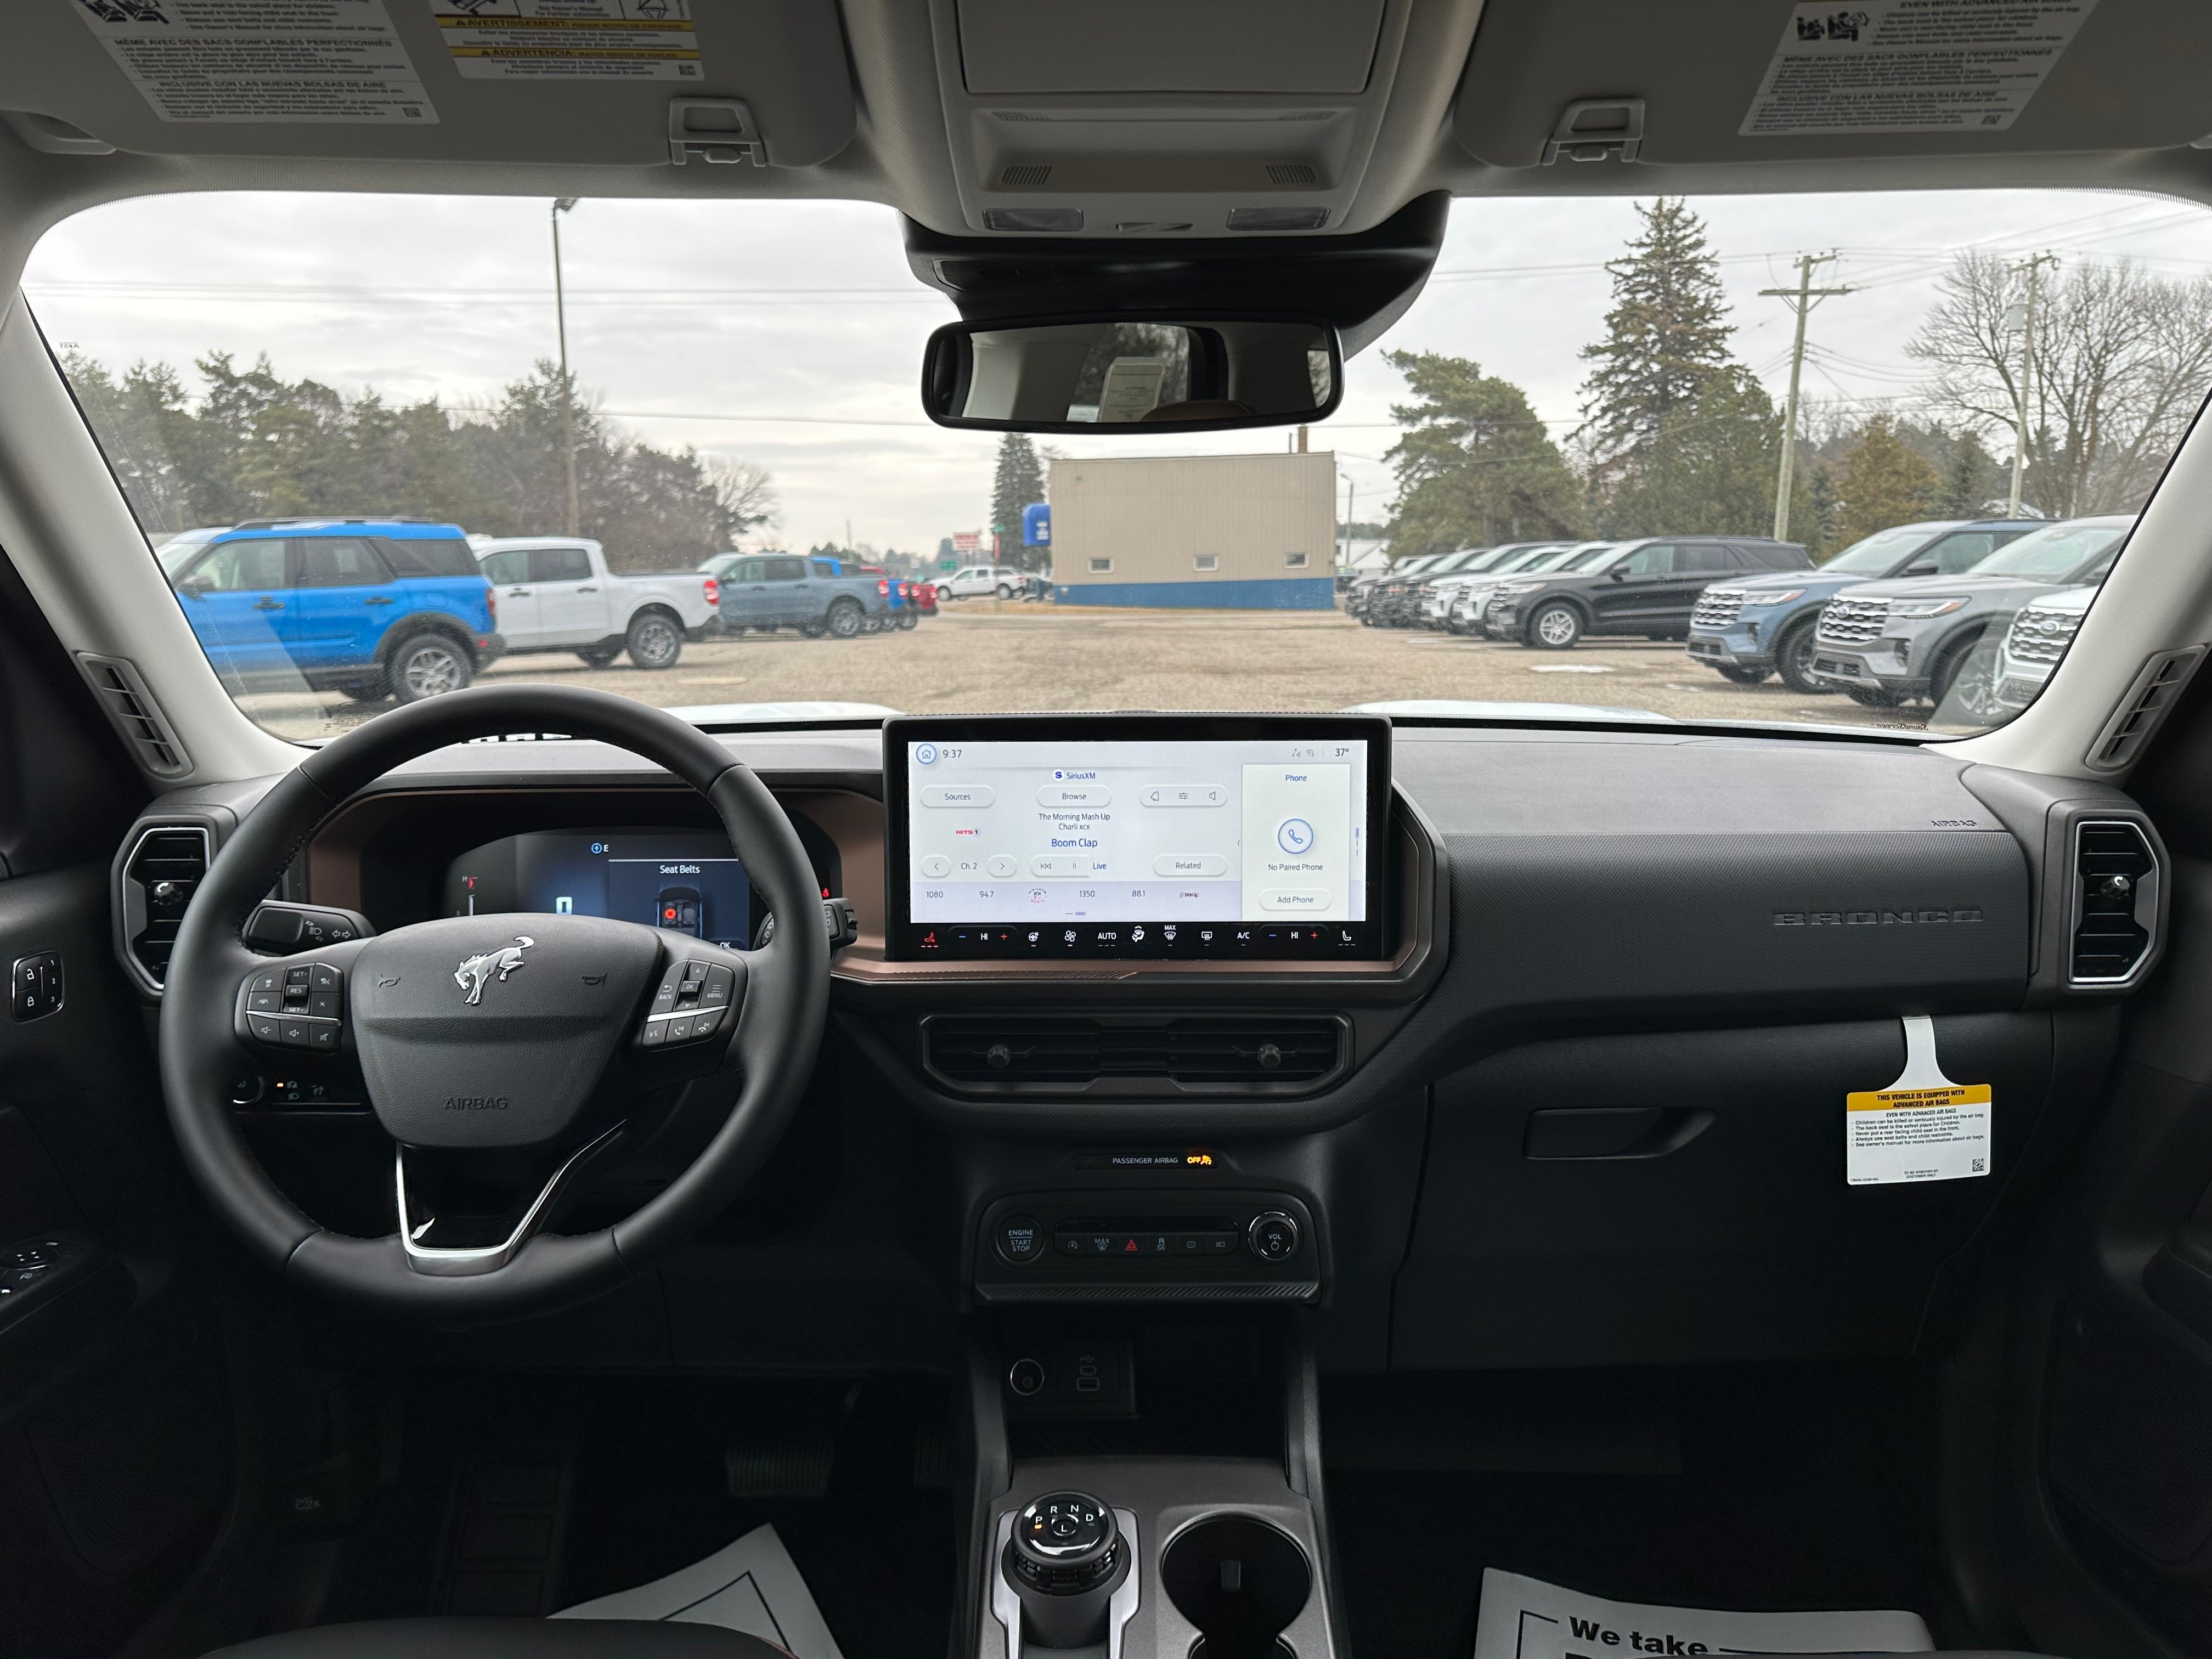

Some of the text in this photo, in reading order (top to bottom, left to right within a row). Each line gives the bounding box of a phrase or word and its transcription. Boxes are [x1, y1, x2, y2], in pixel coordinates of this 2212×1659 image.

[943, 749, 962, 758] 9:37
[1335, 748, 1349, 757] 37°
[1101, 814, 1110, 822] Up
[1052, 838, 1097, 849] Boom Clap
[659, 865, 700, 874] Seat Belts
[1774, 910, 1983, 926] BRONCO
[1924, 1091, 1949, 1099] EQUIPPED
[445, 1097, 508, 1110] AIRBAG
[1061, 1524, 1067, 1532] L
[1569, 1616, 1708, 1656] We take
